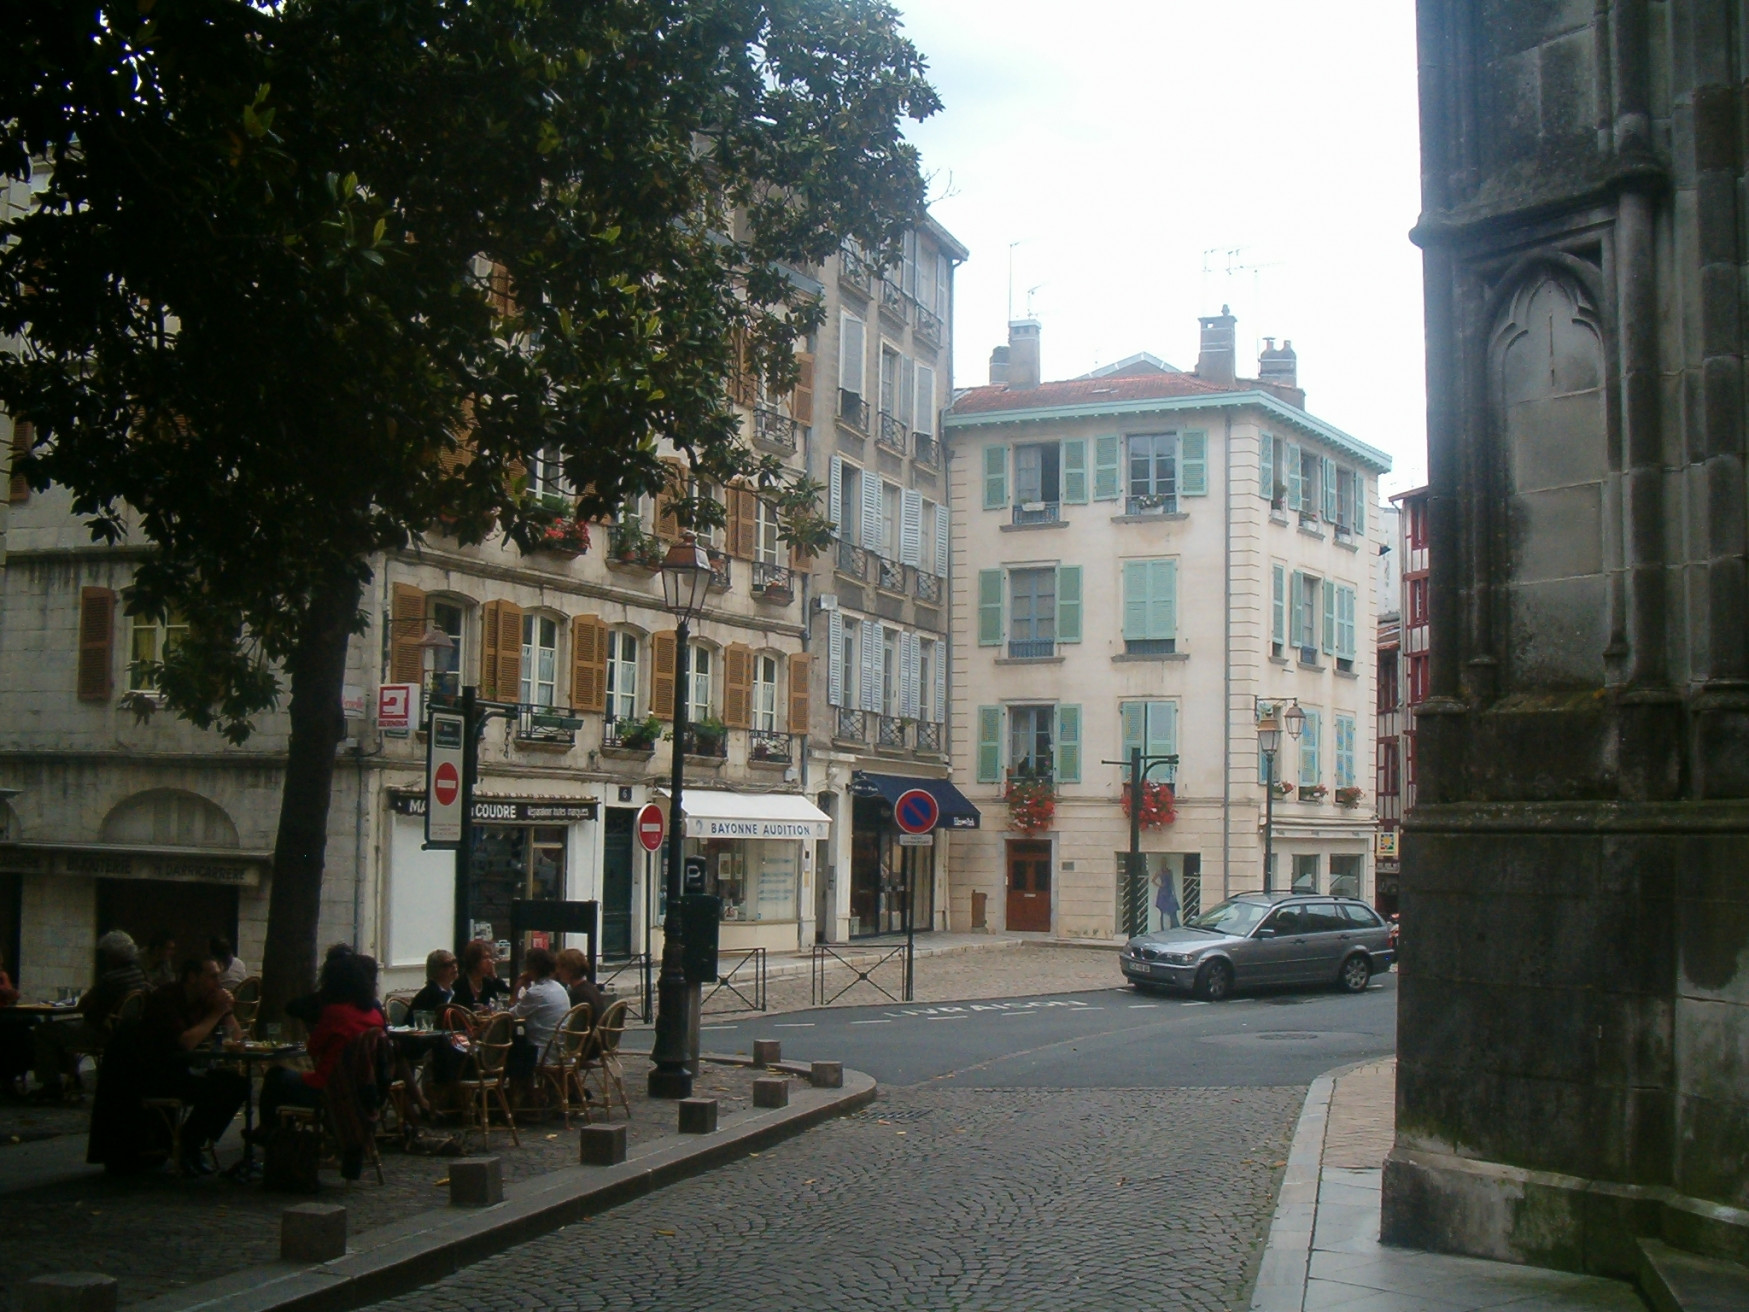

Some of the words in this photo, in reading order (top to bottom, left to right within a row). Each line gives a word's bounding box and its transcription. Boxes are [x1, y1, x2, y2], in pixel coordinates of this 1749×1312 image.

[475, 804, 517, 819] COUDRE
[711, 822, 758, 835] BAYONNE
[763, 824, 810, 836] AUDITION
[686, 865, 701, 884] P
